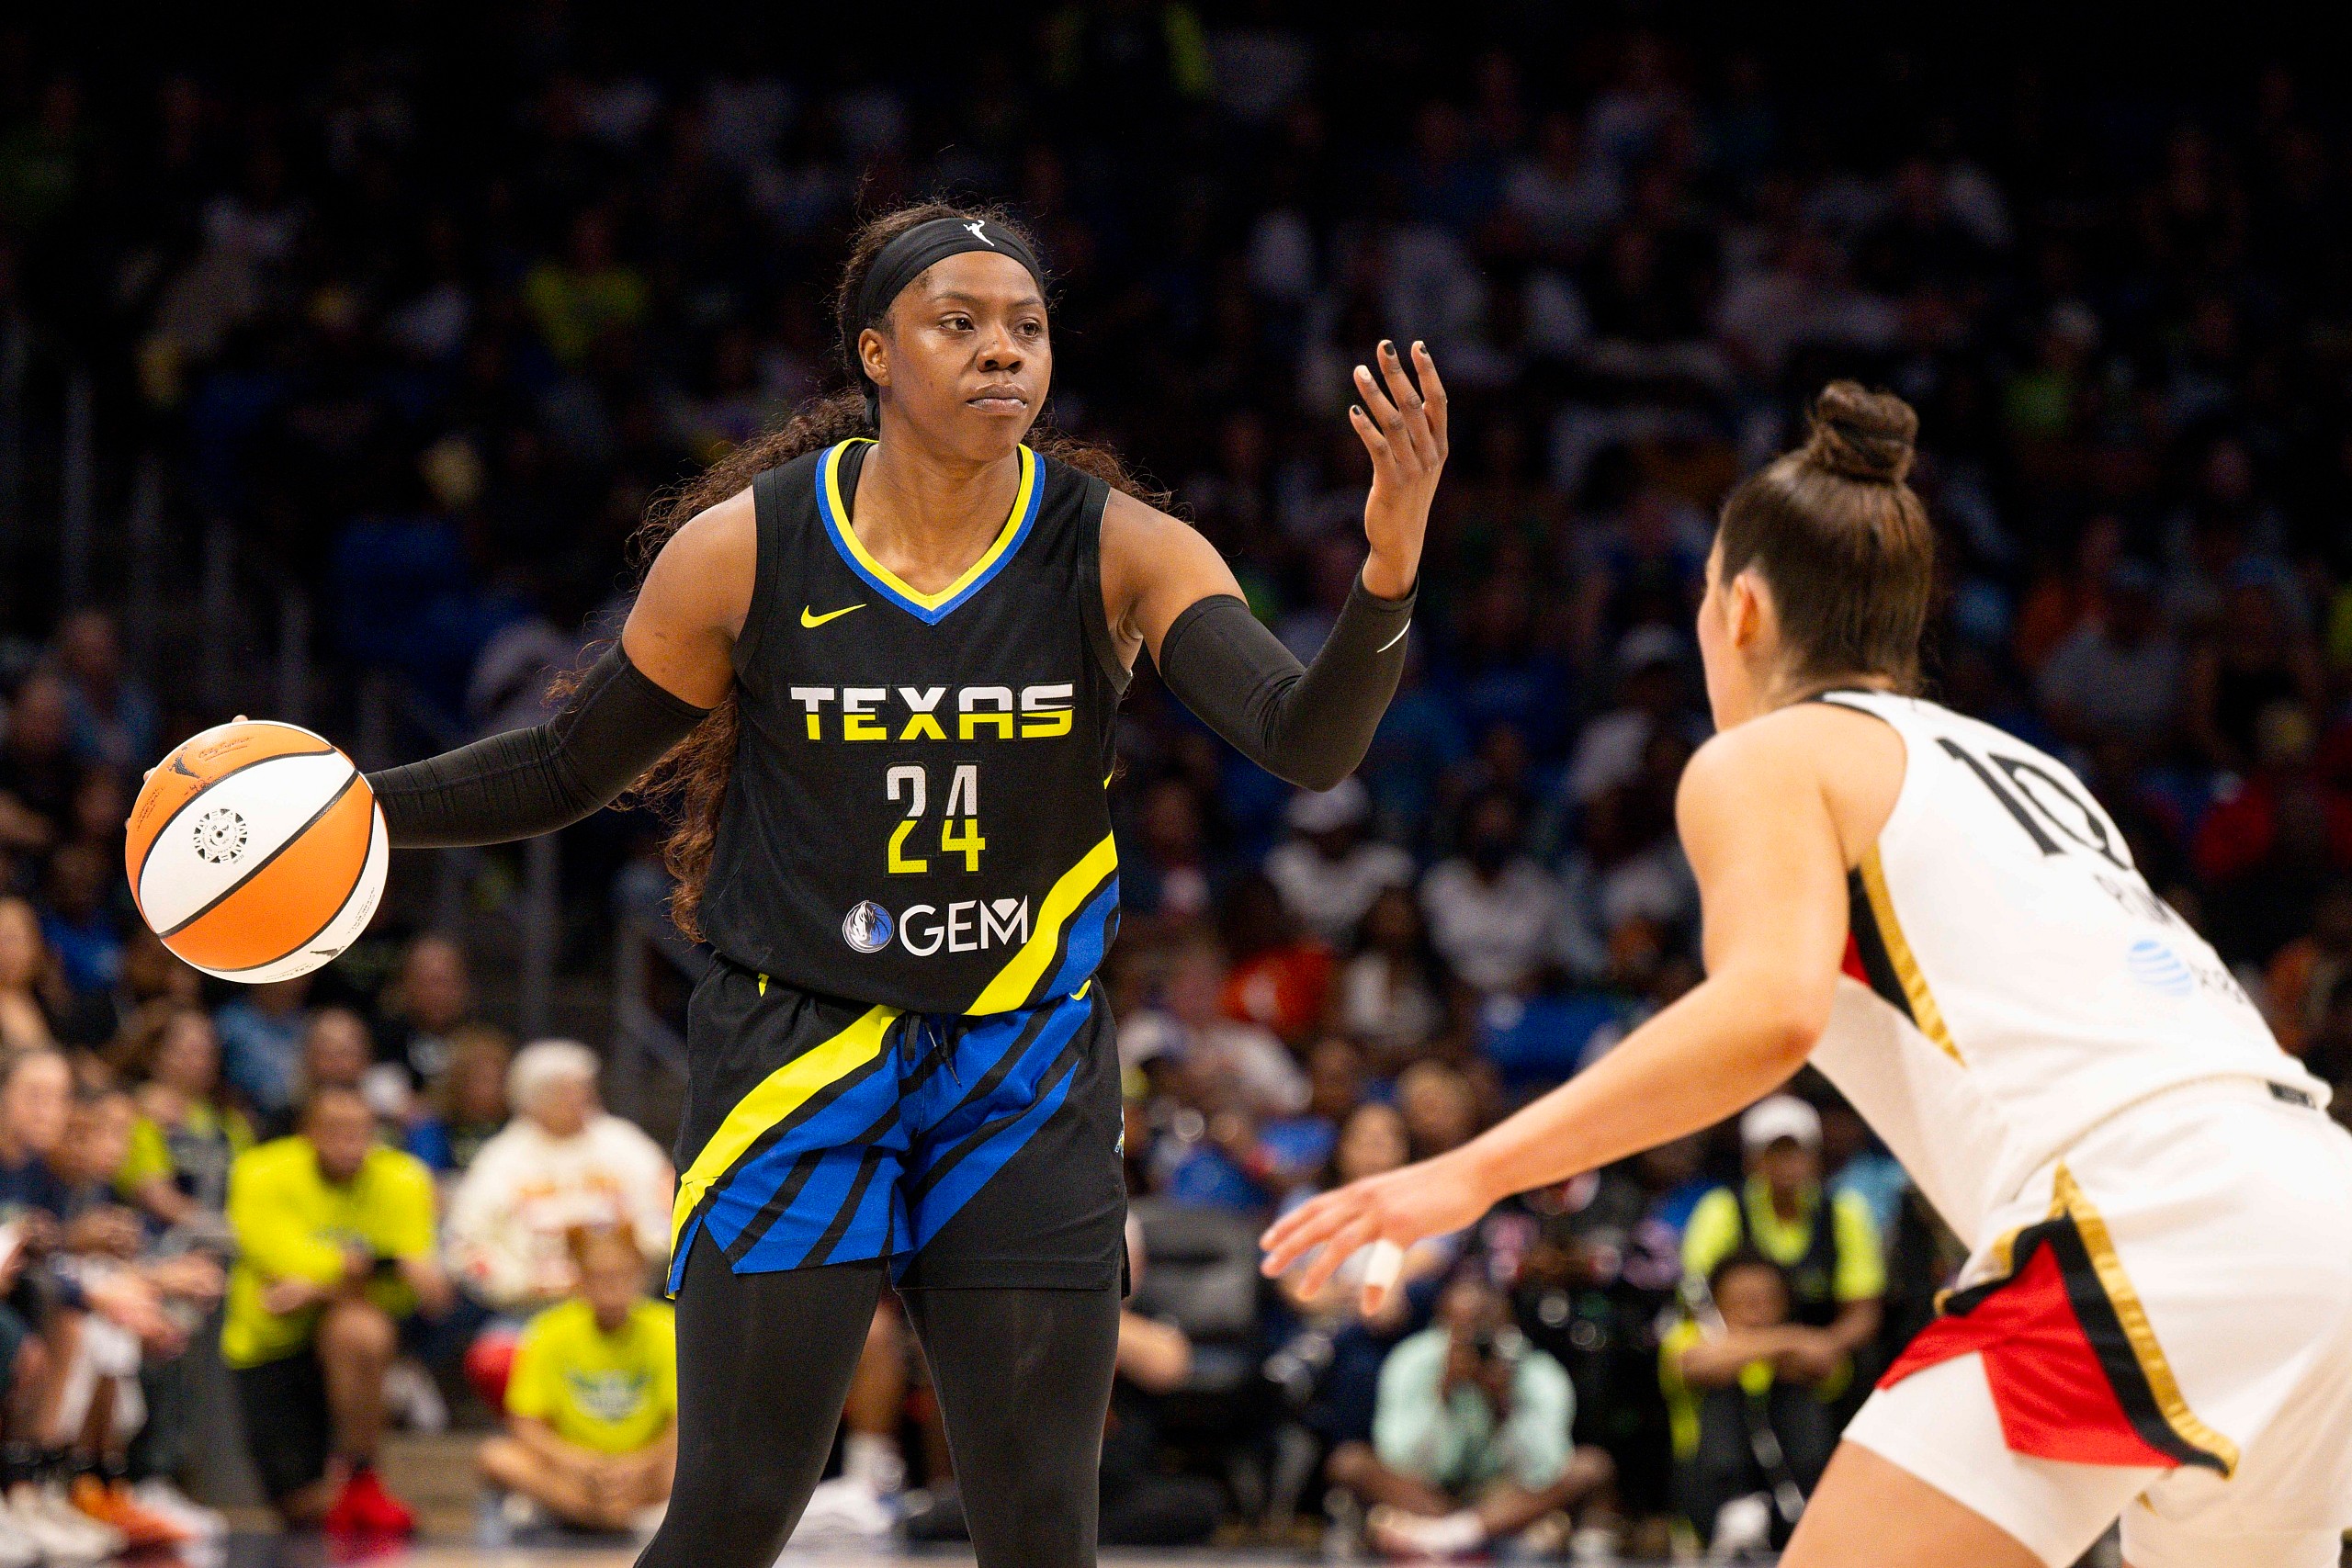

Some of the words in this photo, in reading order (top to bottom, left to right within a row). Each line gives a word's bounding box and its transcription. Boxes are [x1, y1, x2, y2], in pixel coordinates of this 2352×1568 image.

[790, 683, 1074, 740] TEXAS
[887, 765, 985, 874] 24
[1936, 737, 2130, 871] 10
[899, 896, 1029, 957] GEM
